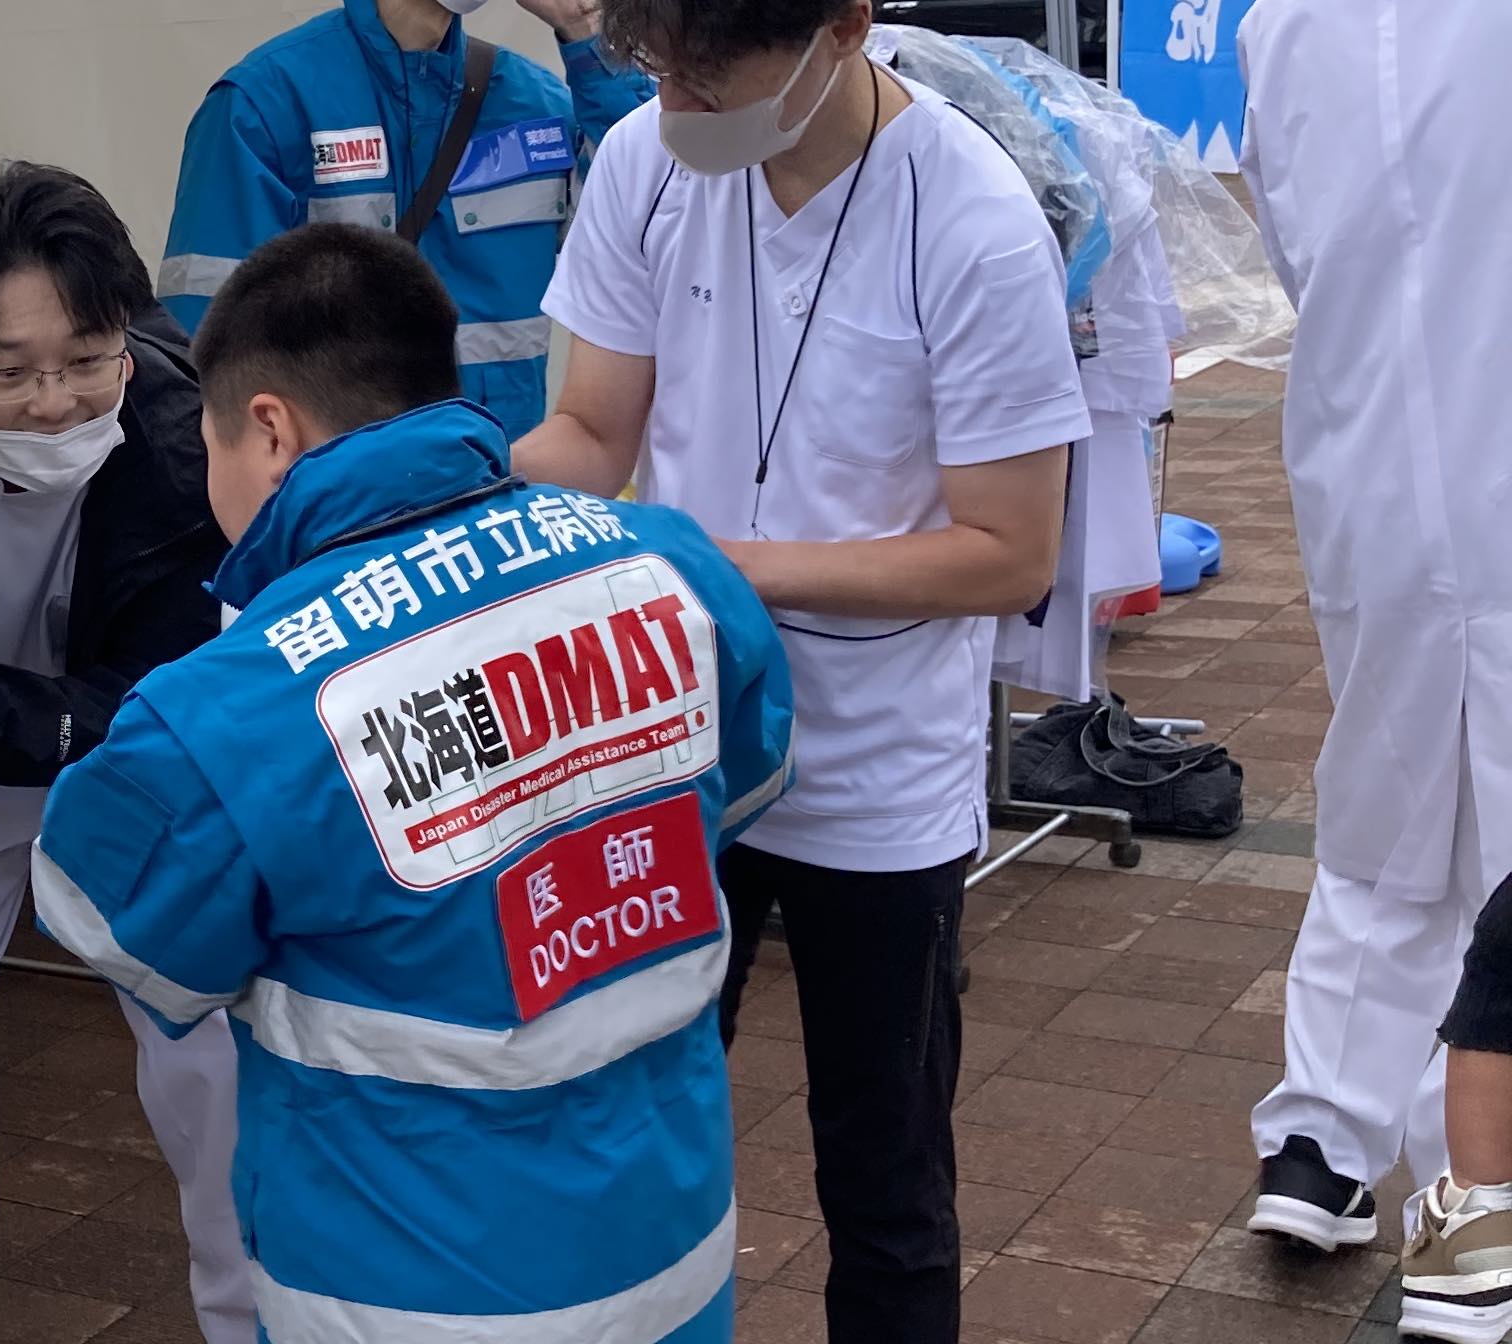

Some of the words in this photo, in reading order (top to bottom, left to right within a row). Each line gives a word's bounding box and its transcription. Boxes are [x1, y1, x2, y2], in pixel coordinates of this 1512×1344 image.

[264, 492, 639, 675] 留萌市立病院
[416, 814, 468, 846] Japan
[470, 785, 518, 822] Disaster
[519, 763, 567, 796] Medical
[567, 736, 648, 773] Assistance
[648, 721, 686, 746] Team
[529, 884, 685, 989] DOCTOR
